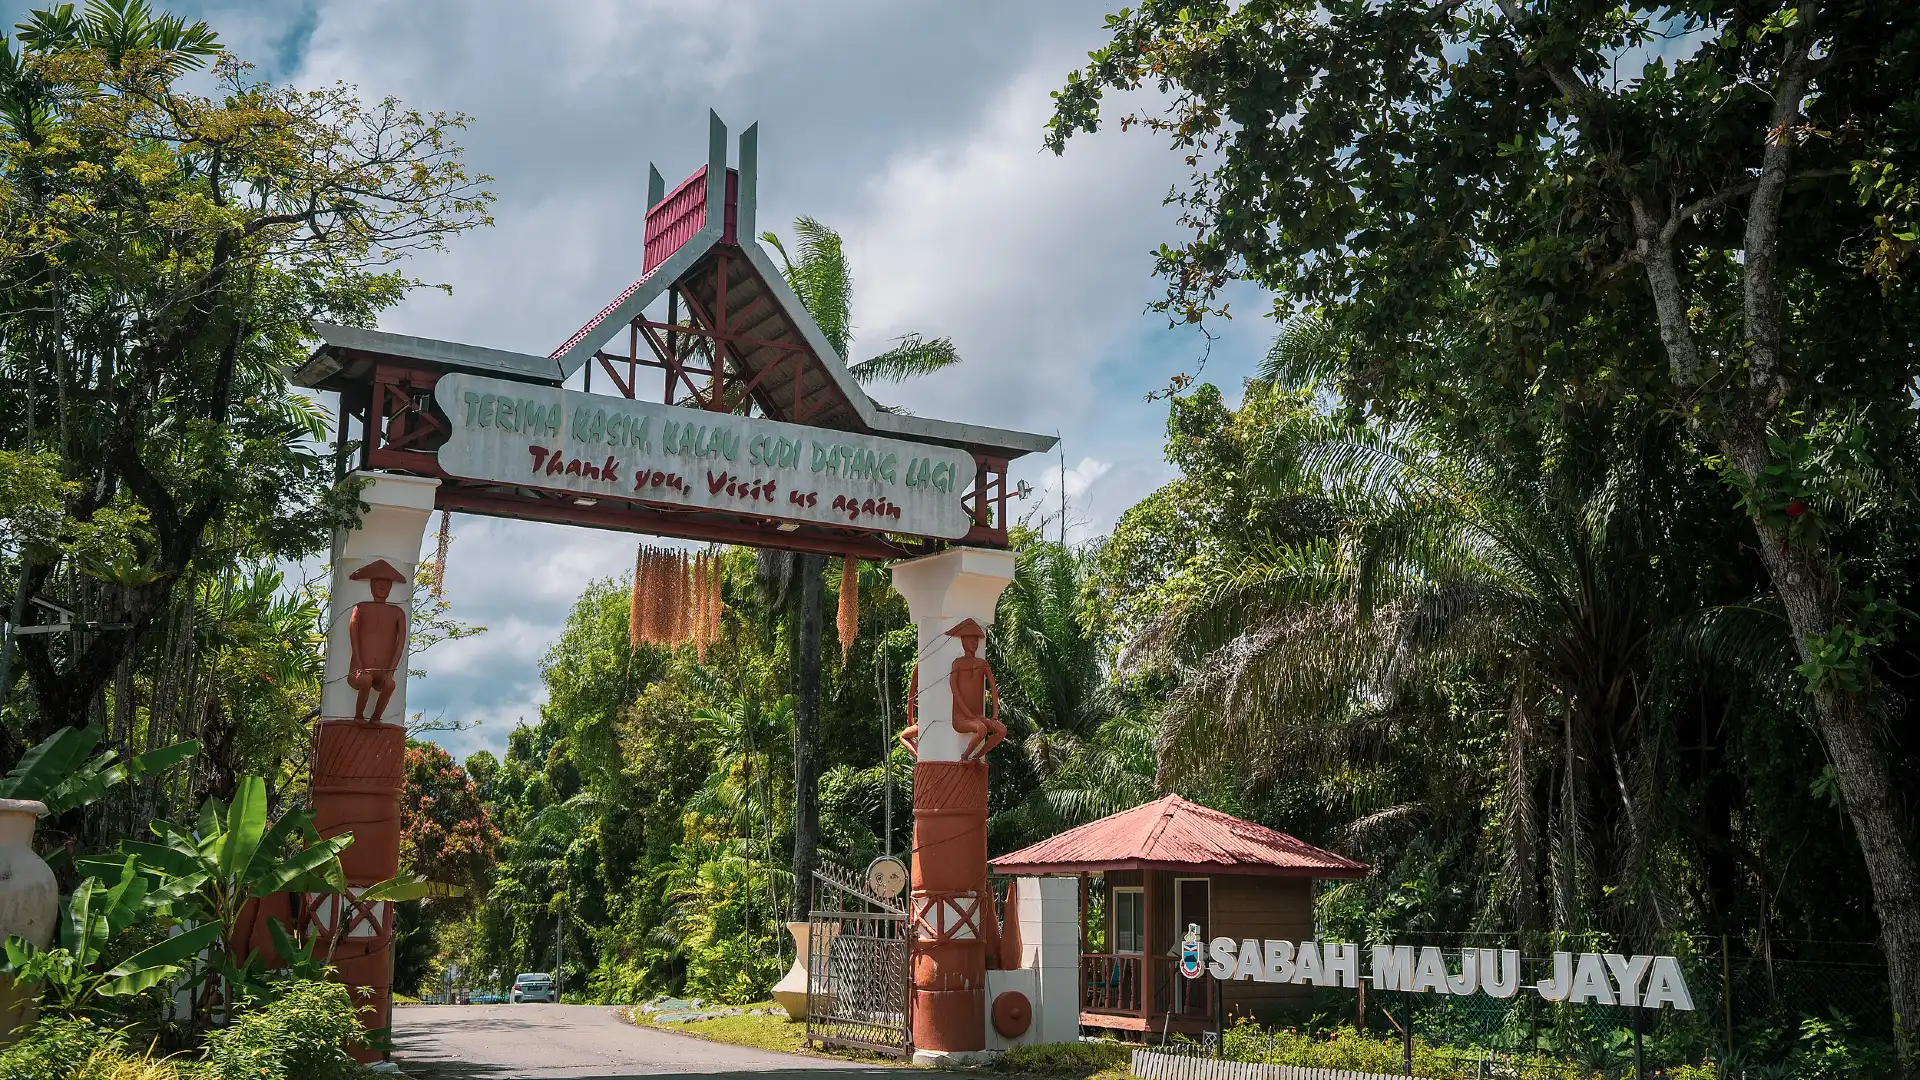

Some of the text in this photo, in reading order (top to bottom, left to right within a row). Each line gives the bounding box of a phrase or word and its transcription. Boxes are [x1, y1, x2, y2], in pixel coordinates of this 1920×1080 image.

[465, 391, 562, 437] TERIMA
[662, 420, 740, 461] KALAU
[749, 433, 802, 470] SUDI
[810, 440, 897, 485] DATANG
[905, 457, 956, 494] LAGI
[528, 445, 901, 521] Thank you, Visit us again
[1209, 936, 1696, 1011] SABAH MAJU JAYA
